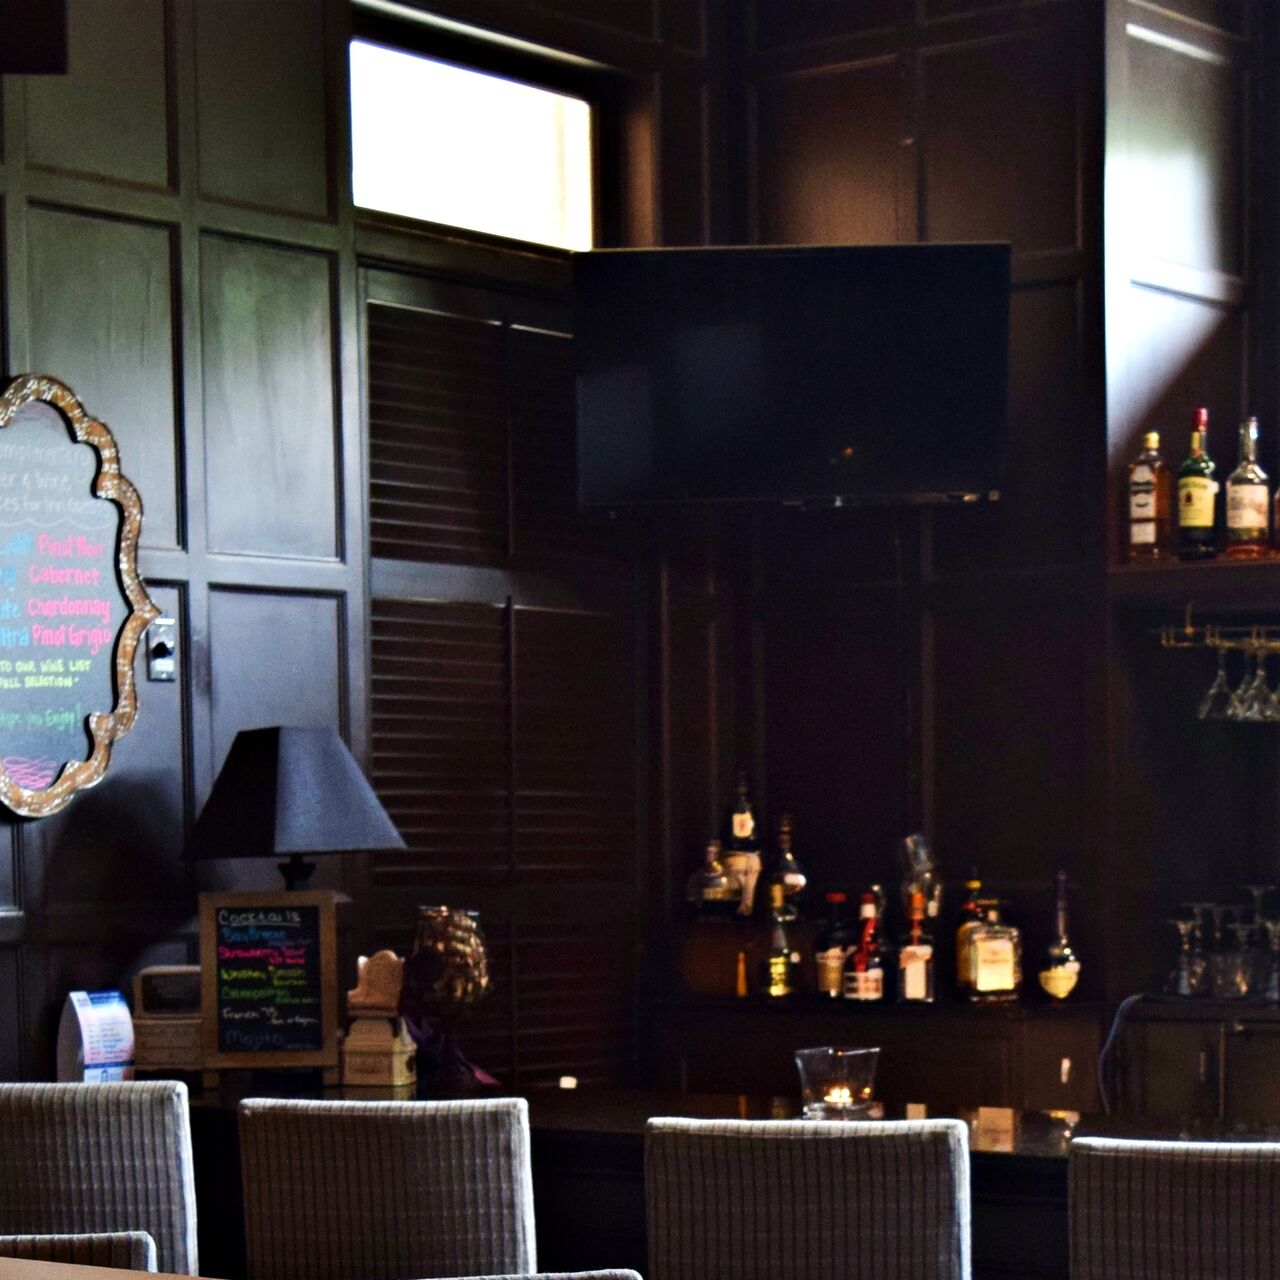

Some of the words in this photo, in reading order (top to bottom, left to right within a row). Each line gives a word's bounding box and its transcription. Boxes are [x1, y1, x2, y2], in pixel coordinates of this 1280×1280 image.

[29, 565, 100, 585] Cabernet
[28, 596, 111, 624] Chardonnay
[32, 623, 66, 647] Pinot
[69, 624, 113, 655] Grigio
[69, 659, 92, 672] LIST
